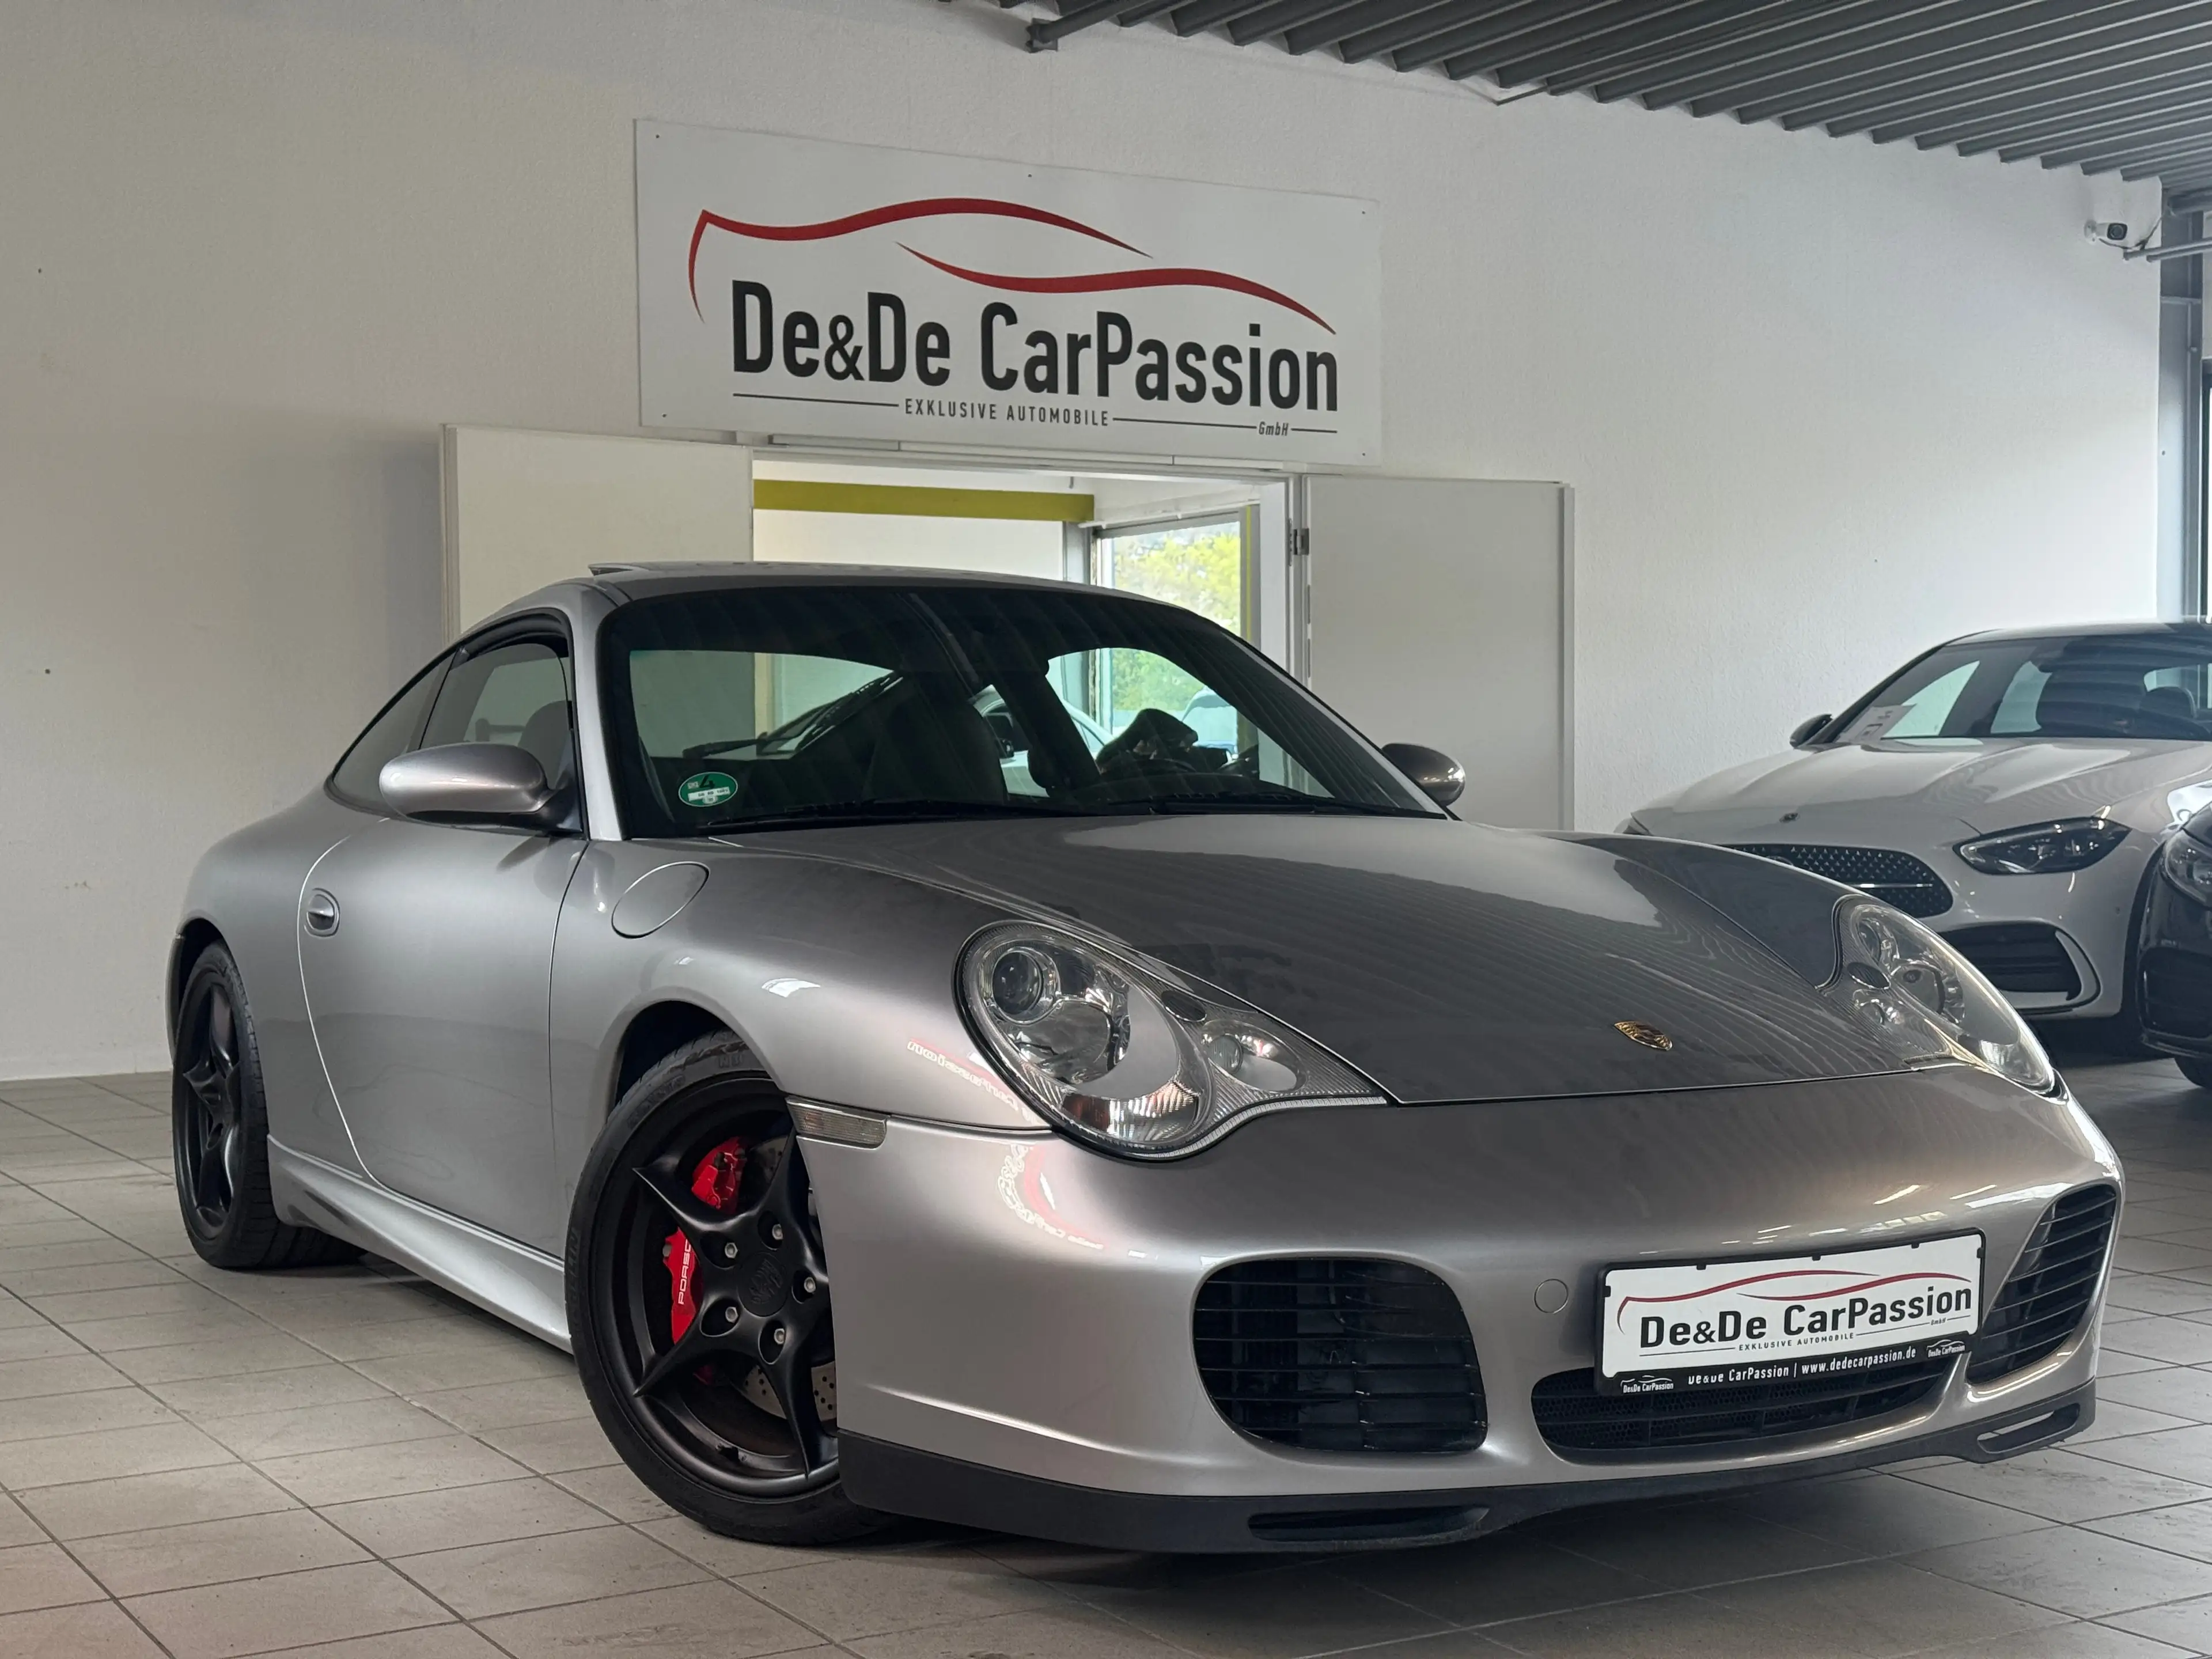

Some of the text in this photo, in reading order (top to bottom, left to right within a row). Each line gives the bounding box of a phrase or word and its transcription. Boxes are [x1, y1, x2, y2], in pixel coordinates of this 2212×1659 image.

[732, 280, 1338, 411] De&De CarPassion
[904, 398, 1108, 426] EXKLUSIVE AUTOMOBILE
[1258, 421, 1289, 436] GmbH
[1640, 1286, 1971, 1349] De&De CarPassion
[1738, 1332, 1854, 1351] EXKLUSIVE AUTOMOBILE
[1728, 1366, 1789, 1381] CarPassion
[1801, 1346, 1916, 1374] www.dedecarpassion.de
[1642, 1381, 1674, 1392] CarPassion
